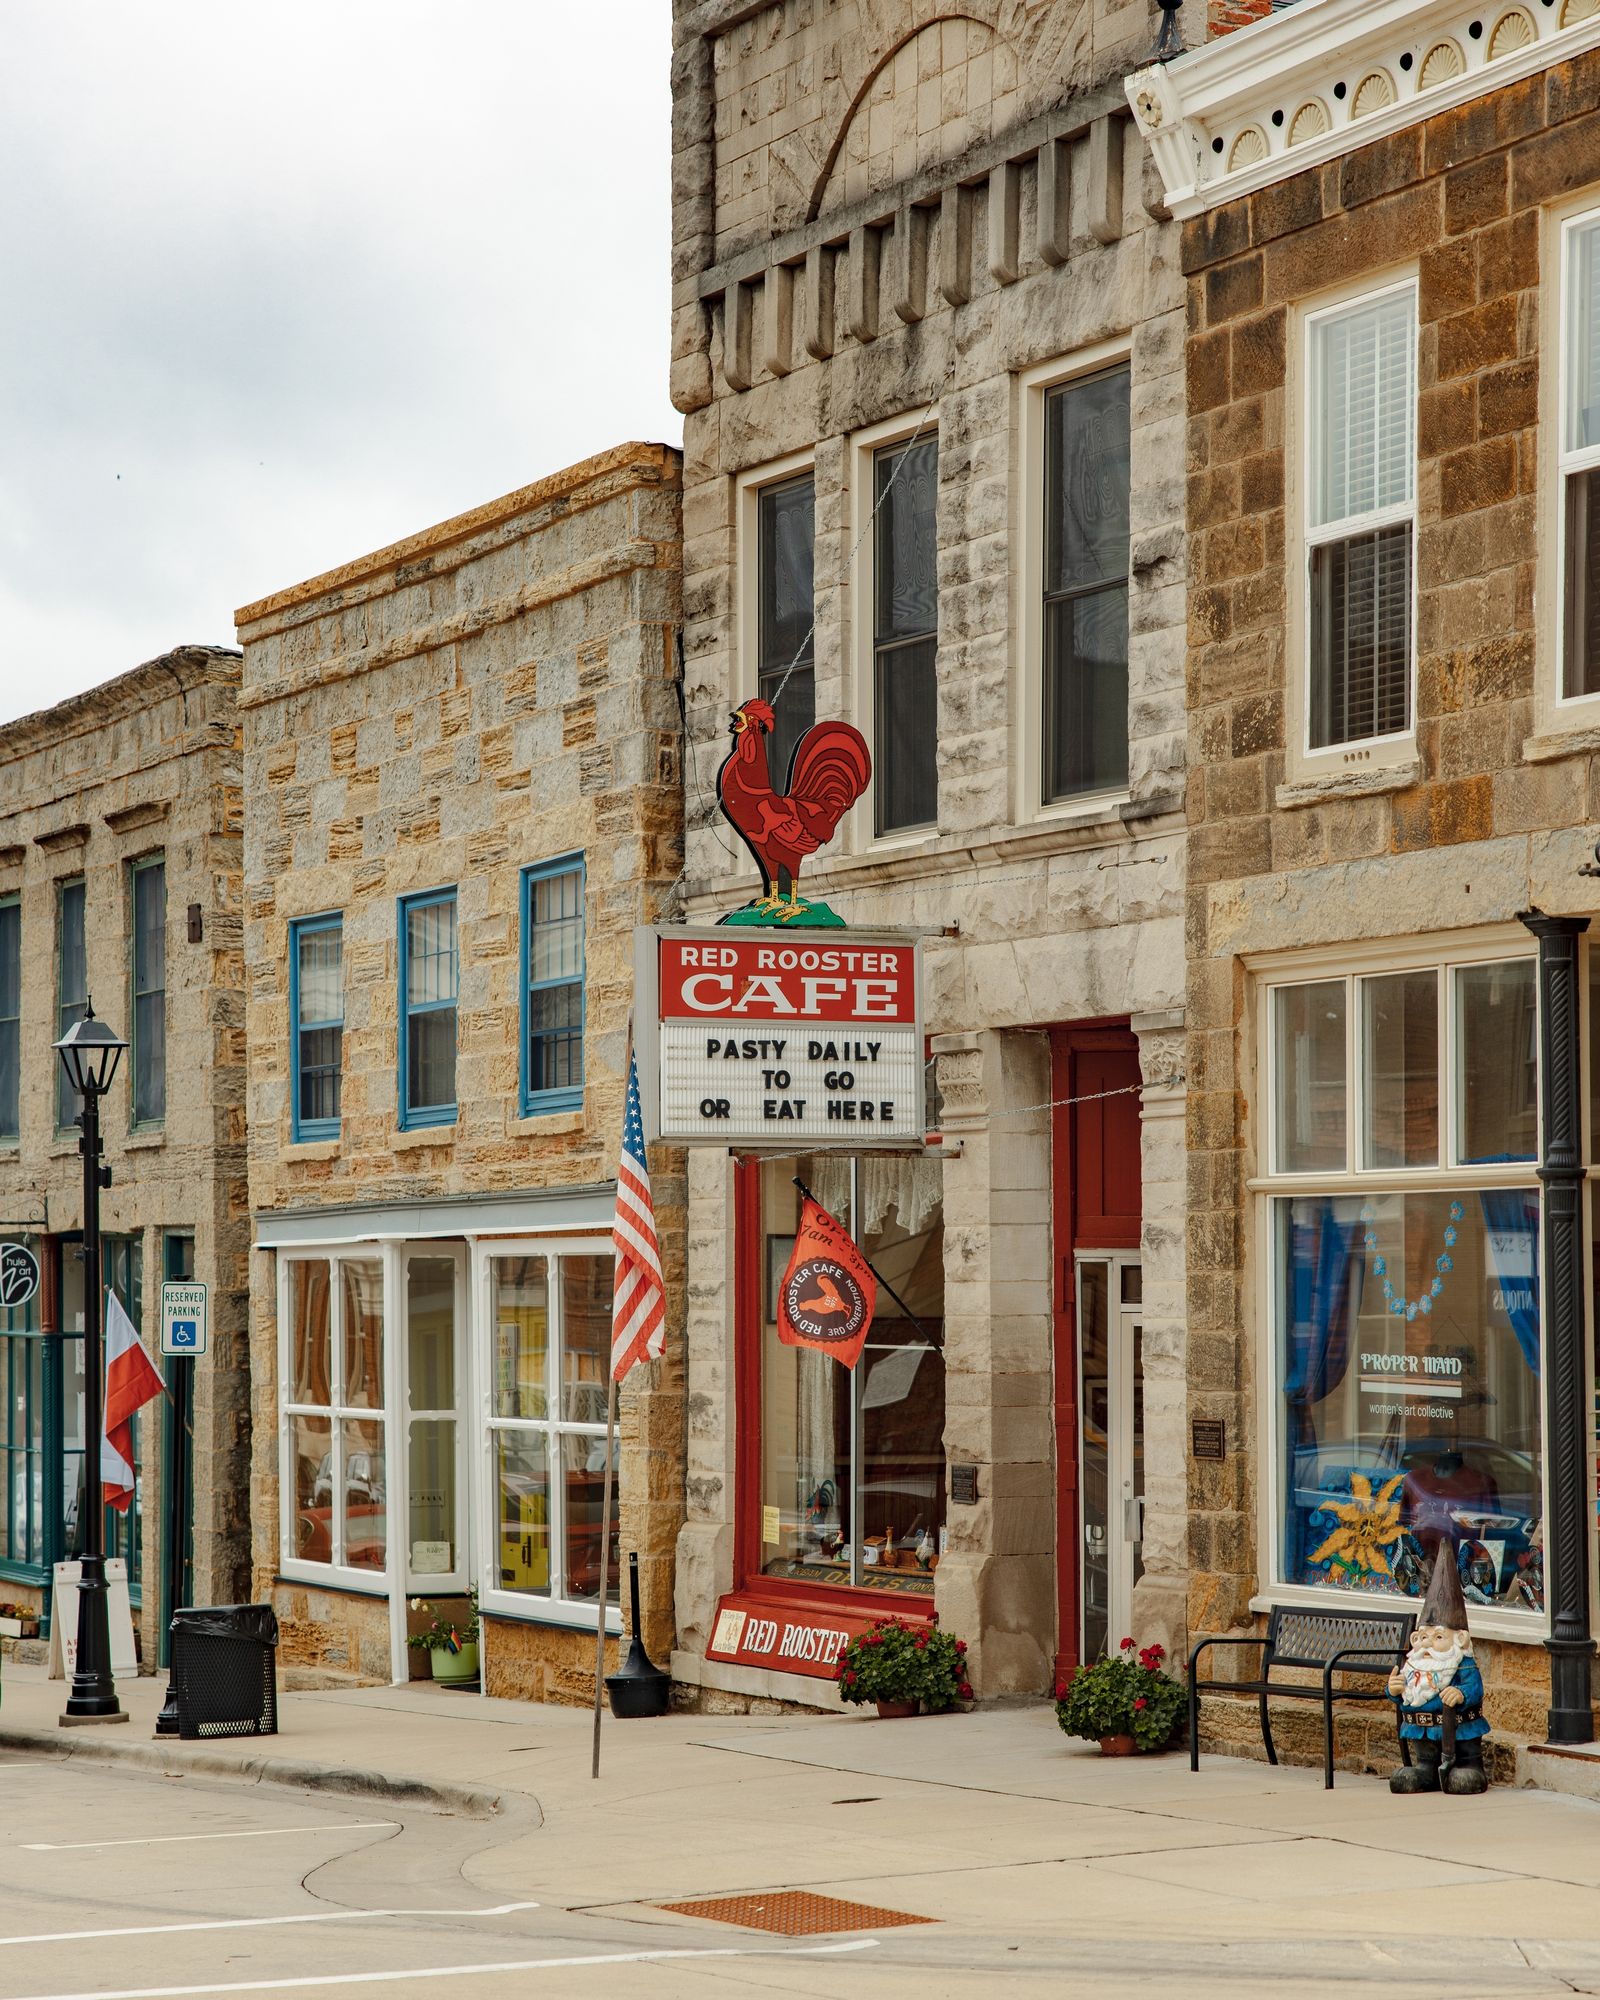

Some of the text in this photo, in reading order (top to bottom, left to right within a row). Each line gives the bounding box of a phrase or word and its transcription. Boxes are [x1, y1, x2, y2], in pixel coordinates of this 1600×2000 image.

[681, 946, 898, 973] RED ROOSTER
[681, 972, 898, 1017] CAFE
[706, 1039, 881, 1062] PASTY DAILY
[762, 1070, 855, 1090] TO GO
[700, 1099, 894, 1121] OR EAT HERE
[801, 1224, 833, 1246] 7am
[18, 1267, 32, 1275] art
[165, 1291, 204, 1302] RESERVED
[788, 1263, 843, 1335] RED ROOSTER CAFE
[827, 1279, 862, 1336] 3RD GENERATION
[168, 1306, 201, 1316] PARKING
[1360, 1353, 1462, 1375] PROPER MAID
[1369, 1403, 1454, 1419] women's art collective
[742, 1618, 778, 1654] RED
